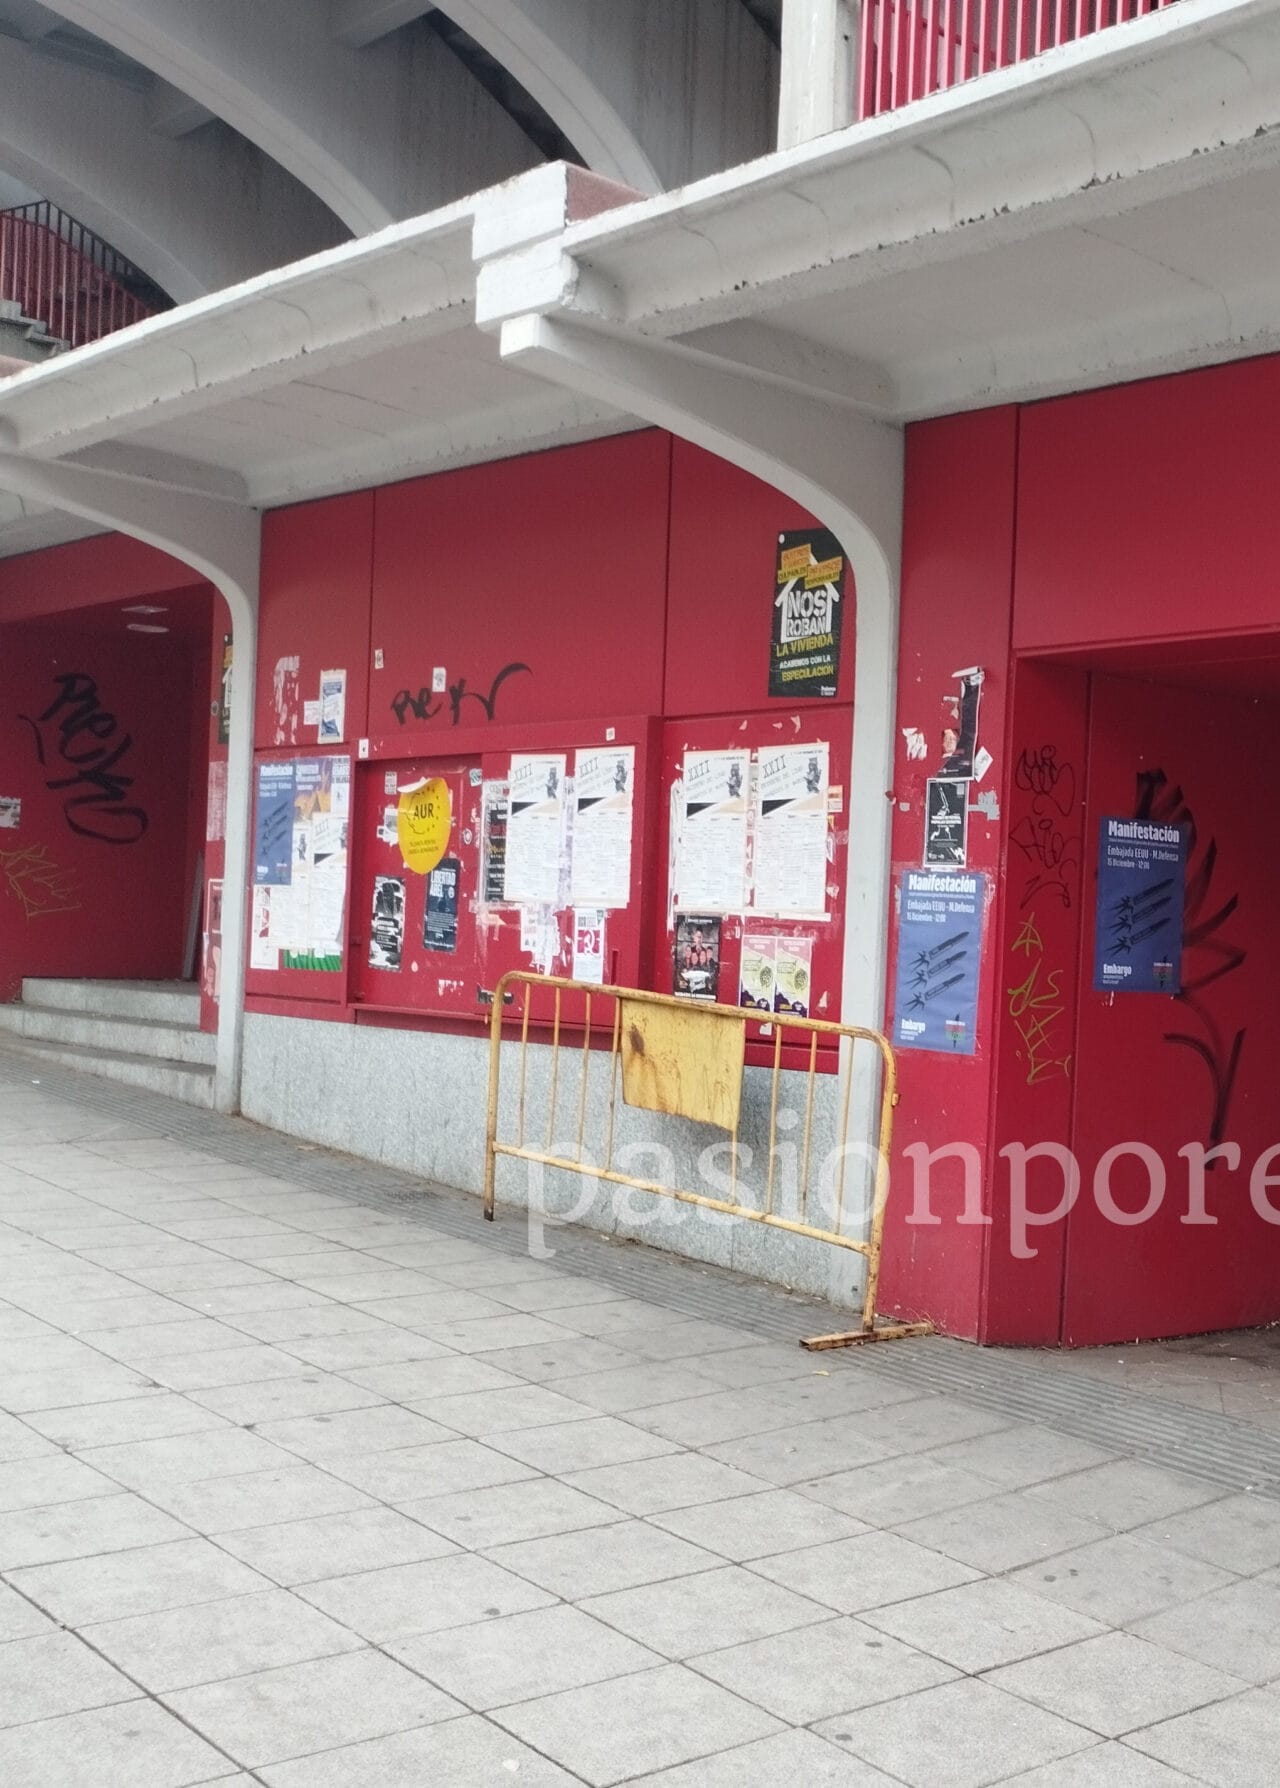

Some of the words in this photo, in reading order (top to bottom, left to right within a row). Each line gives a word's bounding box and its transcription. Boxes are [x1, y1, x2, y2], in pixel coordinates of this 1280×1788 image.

[787, 590, 827, 618] NOS
[786, 616, 826, 637] ROBAN
[777, 643, 789, 658] LA
[790, 633, 834, 654] VIVIENDA
[780, 657, 809, 670] ACABEMOS
[810, 655, 822, 665] CON
[823, 654, 831, 663] LA
[414, 803, 434, 820] AUR
[1108, 820, 1180, 843] Manifestación
[1107, 845, 1134, 858] Embajada
[1134, 847, 1149, 859] EEUU
[1112, 858, 1135, 868] Diciembre
[908, 874, 977, 893] Manifestación
[907, 899, 932, 912] Embajada
[1103, 963, 1132, 978] Embargo
